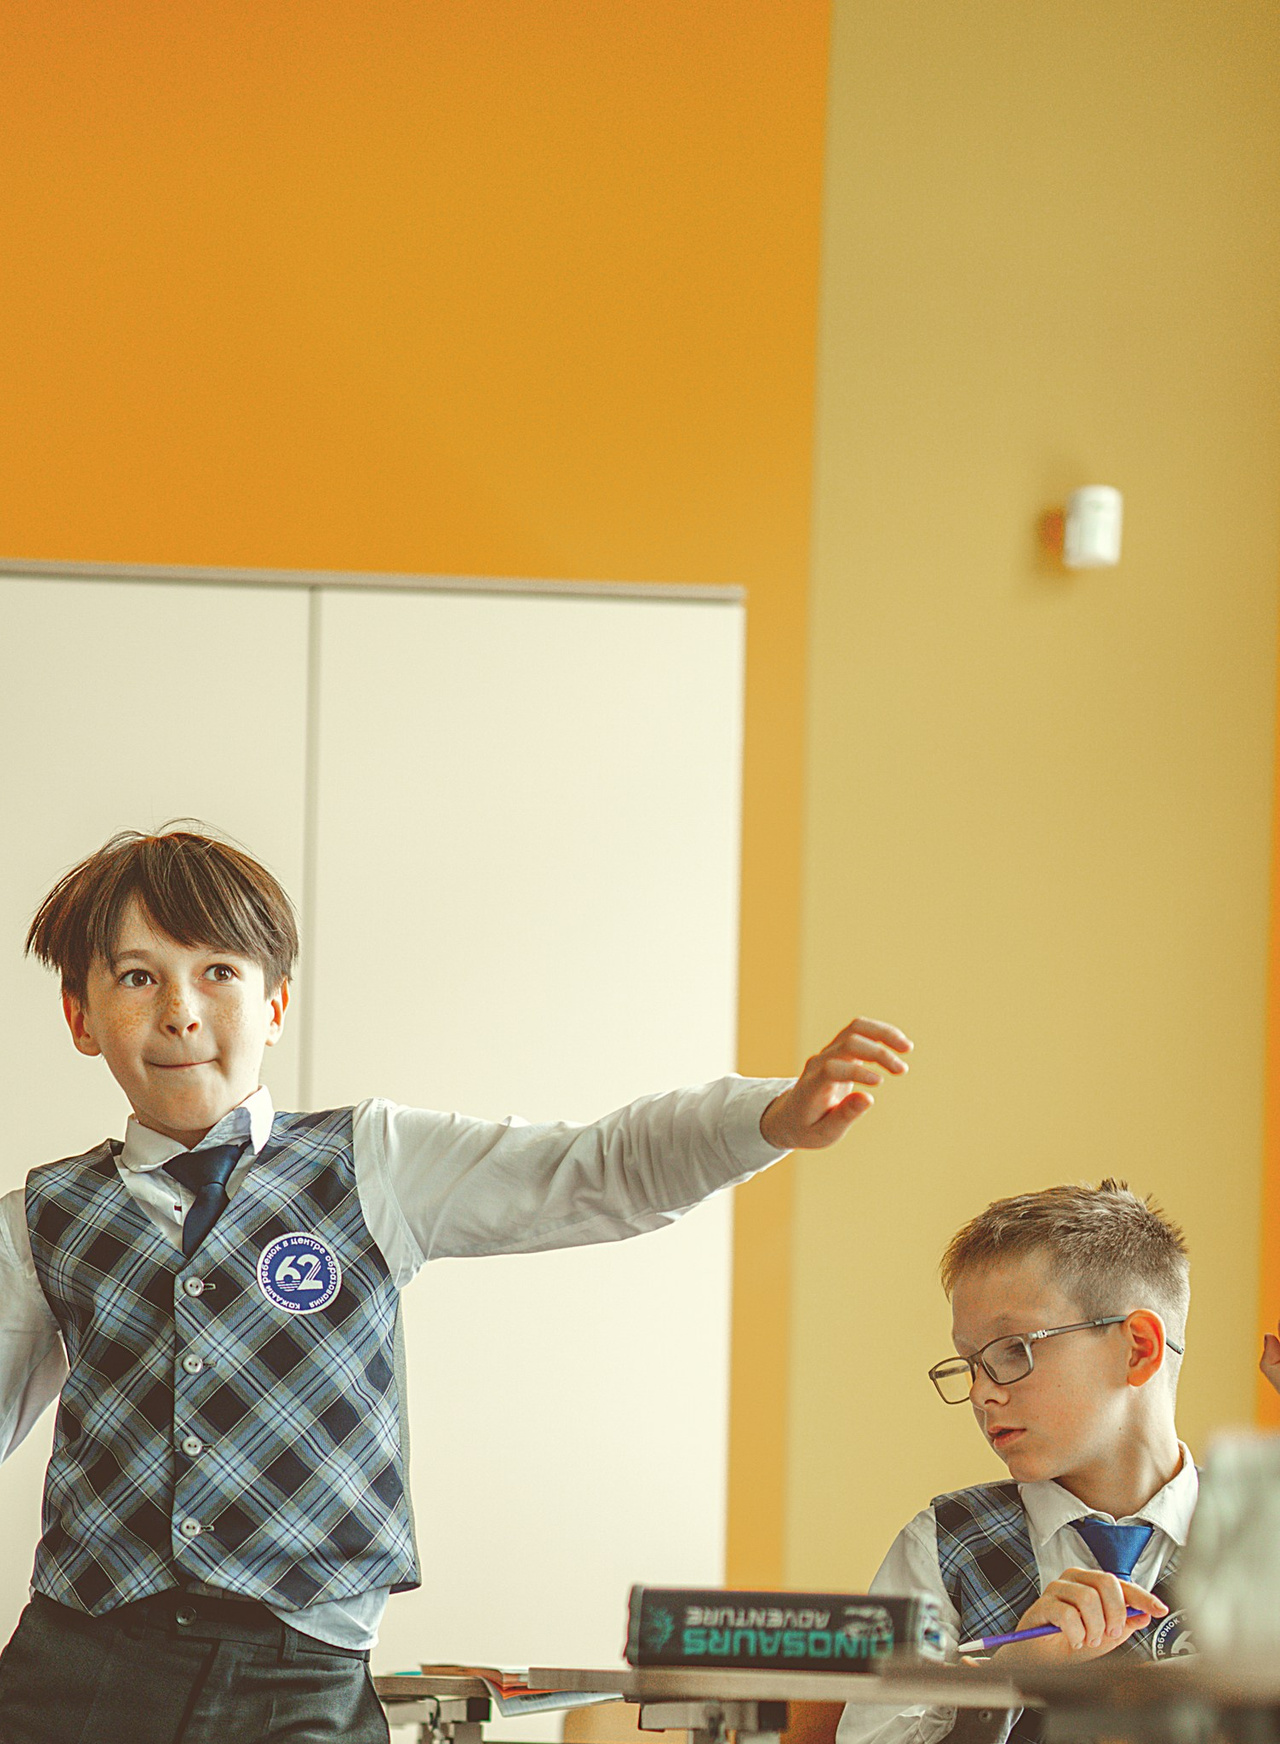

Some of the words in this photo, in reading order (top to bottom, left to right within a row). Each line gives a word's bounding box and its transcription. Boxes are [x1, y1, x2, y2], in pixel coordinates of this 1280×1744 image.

[262, 1245, 282, 1284] ребенок
[290, 1237, 326, 1254] центре
[309, 1255, 337, 1308] образования
[275, 1254, 323, 1291] 62
[685, 1606, 831, 1628] ADVENTURE
[682, 1628, 894, 1659] DINOSAURS
[1157, 1618, 1180, 1656] ребенок
